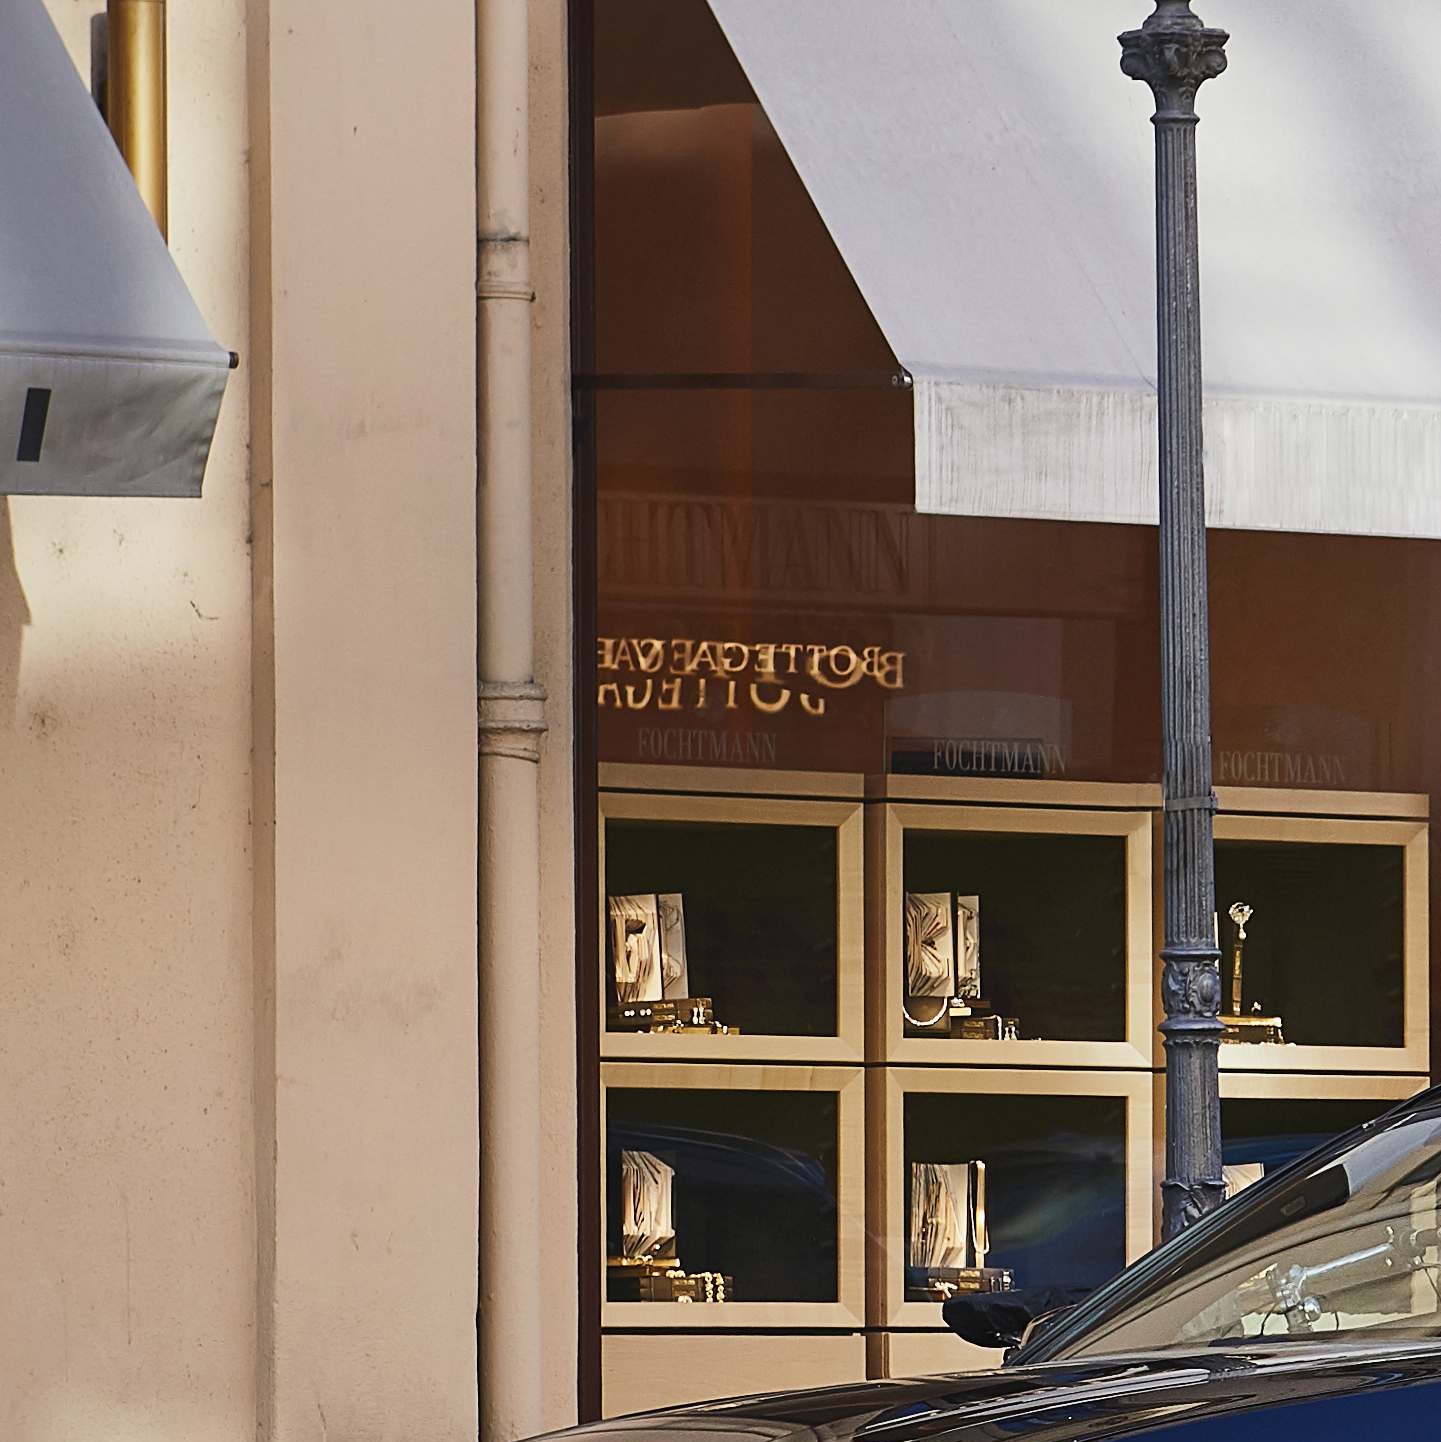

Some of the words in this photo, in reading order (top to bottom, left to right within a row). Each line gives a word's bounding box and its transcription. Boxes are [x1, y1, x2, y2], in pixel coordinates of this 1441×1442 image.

[638, 727, 777, 764] FOCHTMANN
[932, 739, 1067, 775] FOCHTMANN
[1218, 751, 1346, 785] FOCHTMANN
